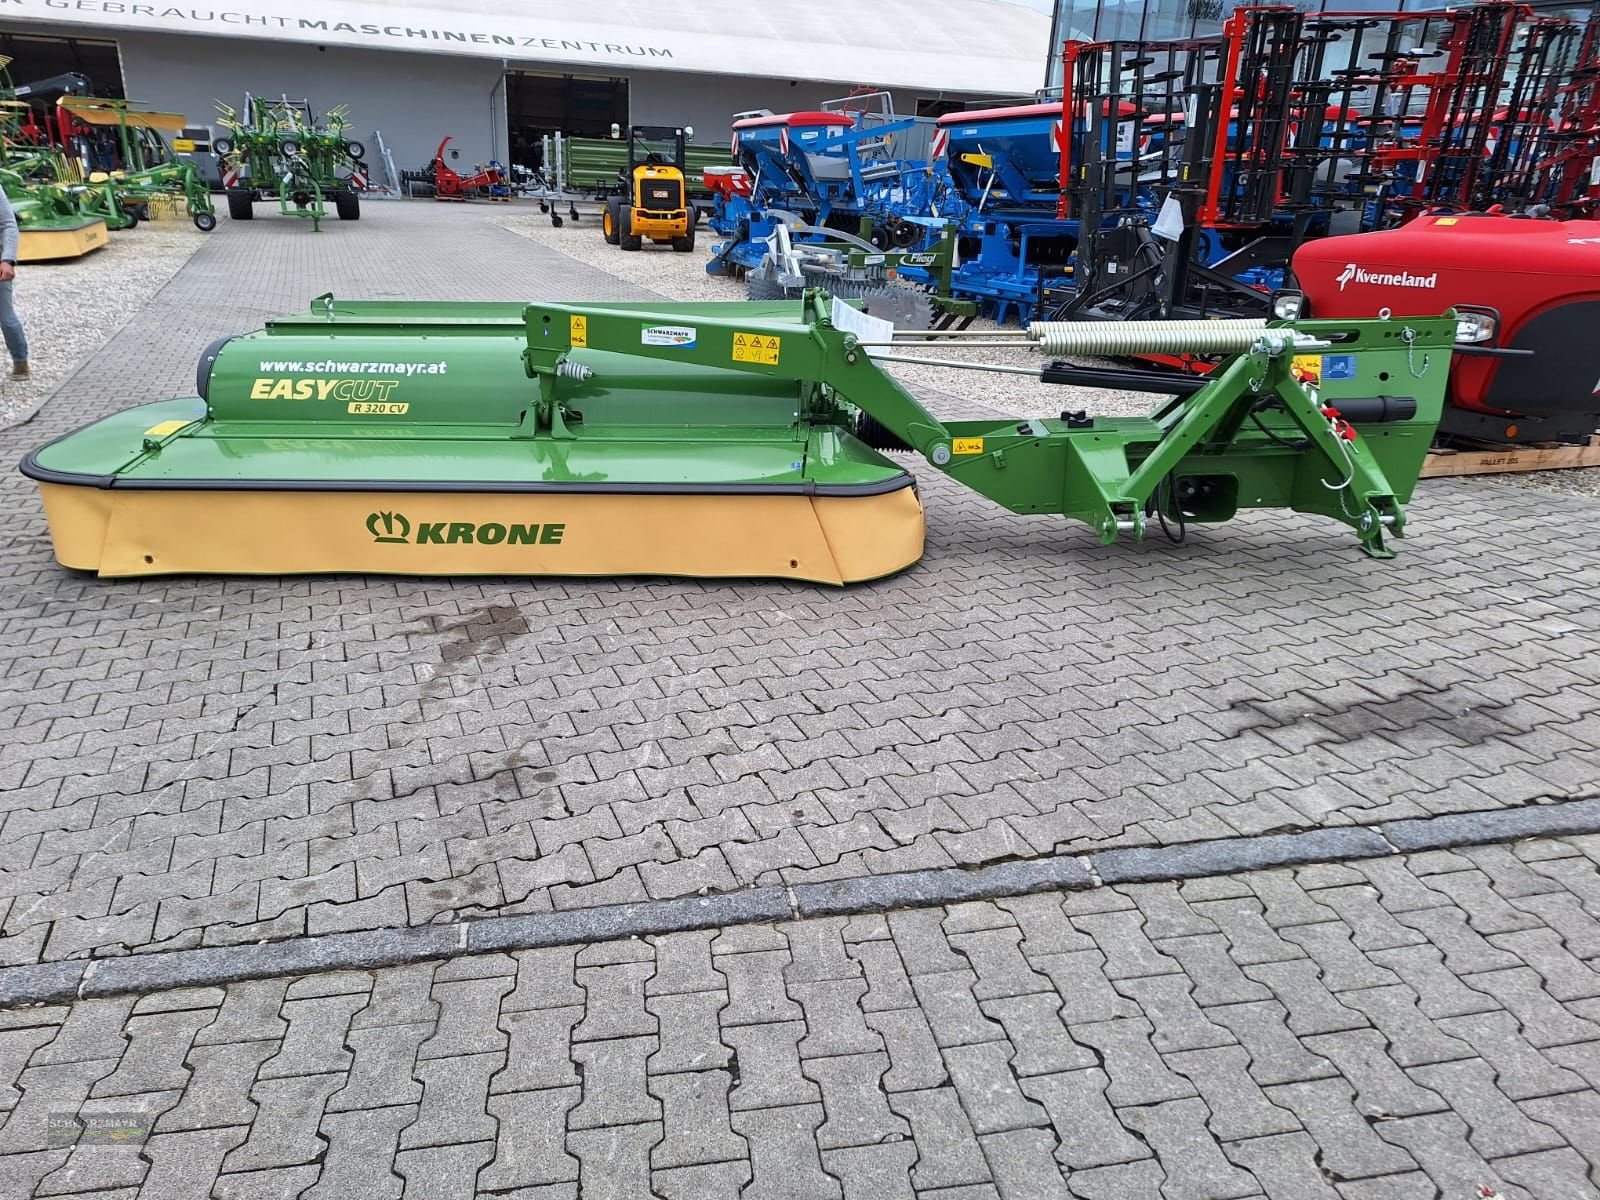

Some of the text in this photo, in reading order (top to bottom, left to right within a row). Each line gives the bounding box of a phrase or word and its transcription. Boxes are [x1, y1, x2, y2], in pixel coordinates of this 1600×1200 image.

[46, 0, 673, 57] GEBRAUCHTMASCHINENZENTRUM
[910, 253, 937, 265] Fliegl
[1355, 268, 1438, 288] Kverneland
[259, 360, 448, 376] www.schwarzmayr.at
[250, 378, 399, 401] EASYCUT
[353, 403, 406, 414] R 320 CV
[416, 522, 566, 545] KRONE
